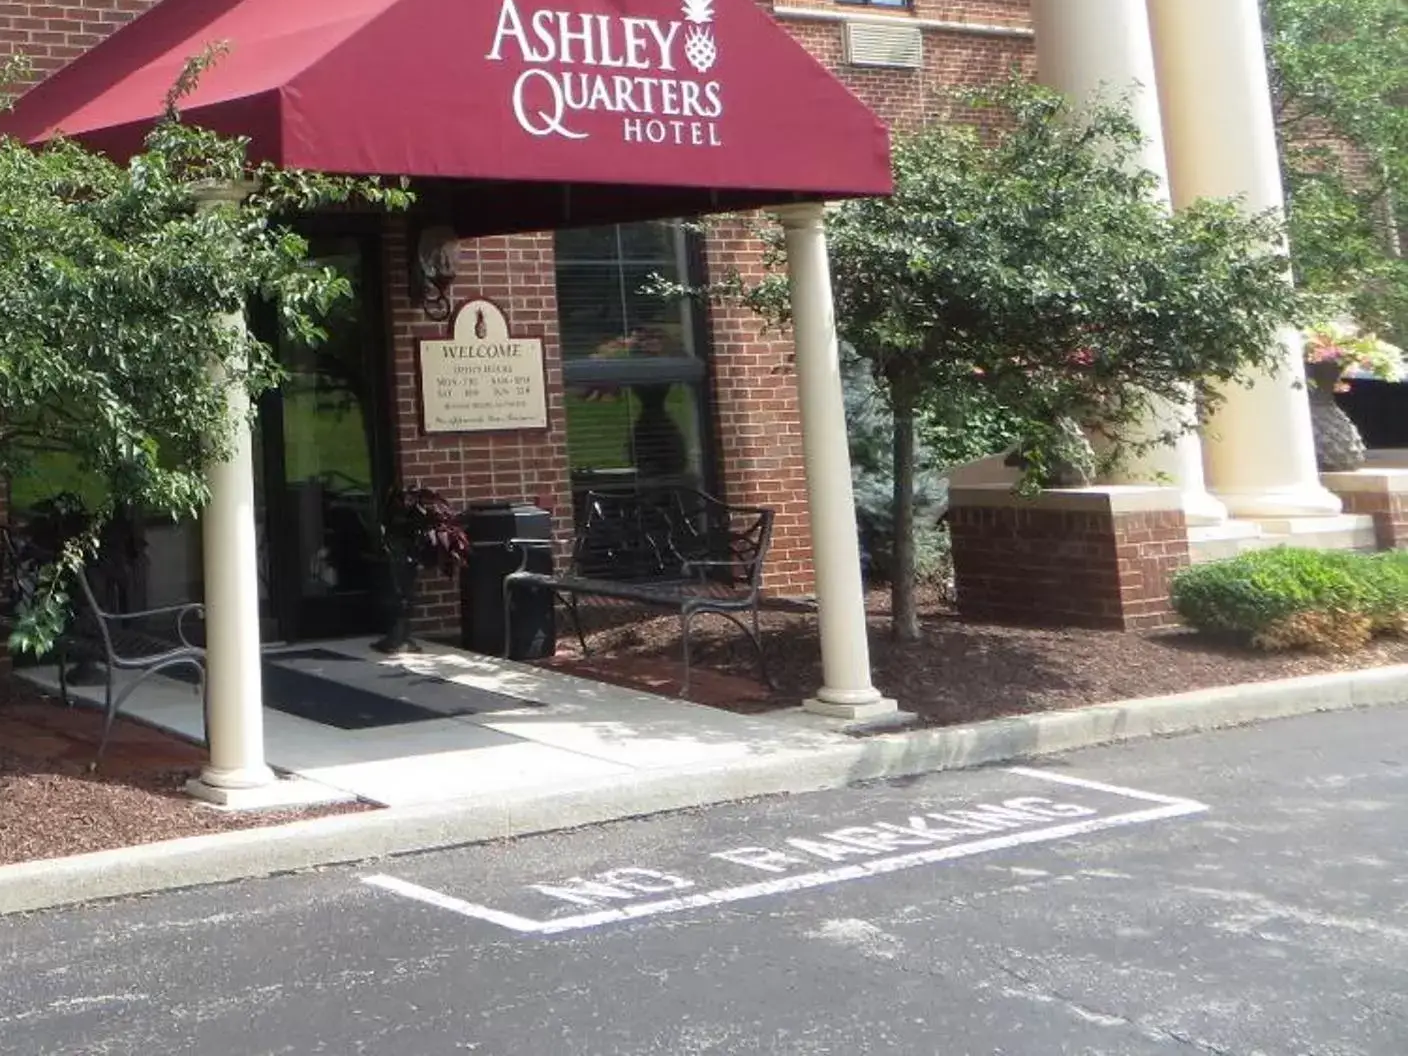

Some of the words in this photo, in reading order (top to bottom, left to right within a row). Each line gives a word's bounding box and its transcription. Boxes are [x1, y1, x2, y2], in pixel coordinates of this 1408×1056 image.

[512, 68, 723, 139] QUARTERS
[624, 118, 722, 146] HOTEL
[442, 343, 521, 359] WELCOME
[526, 867, 695, 906] NO
[710, 796, 1098, 874] PARKING
